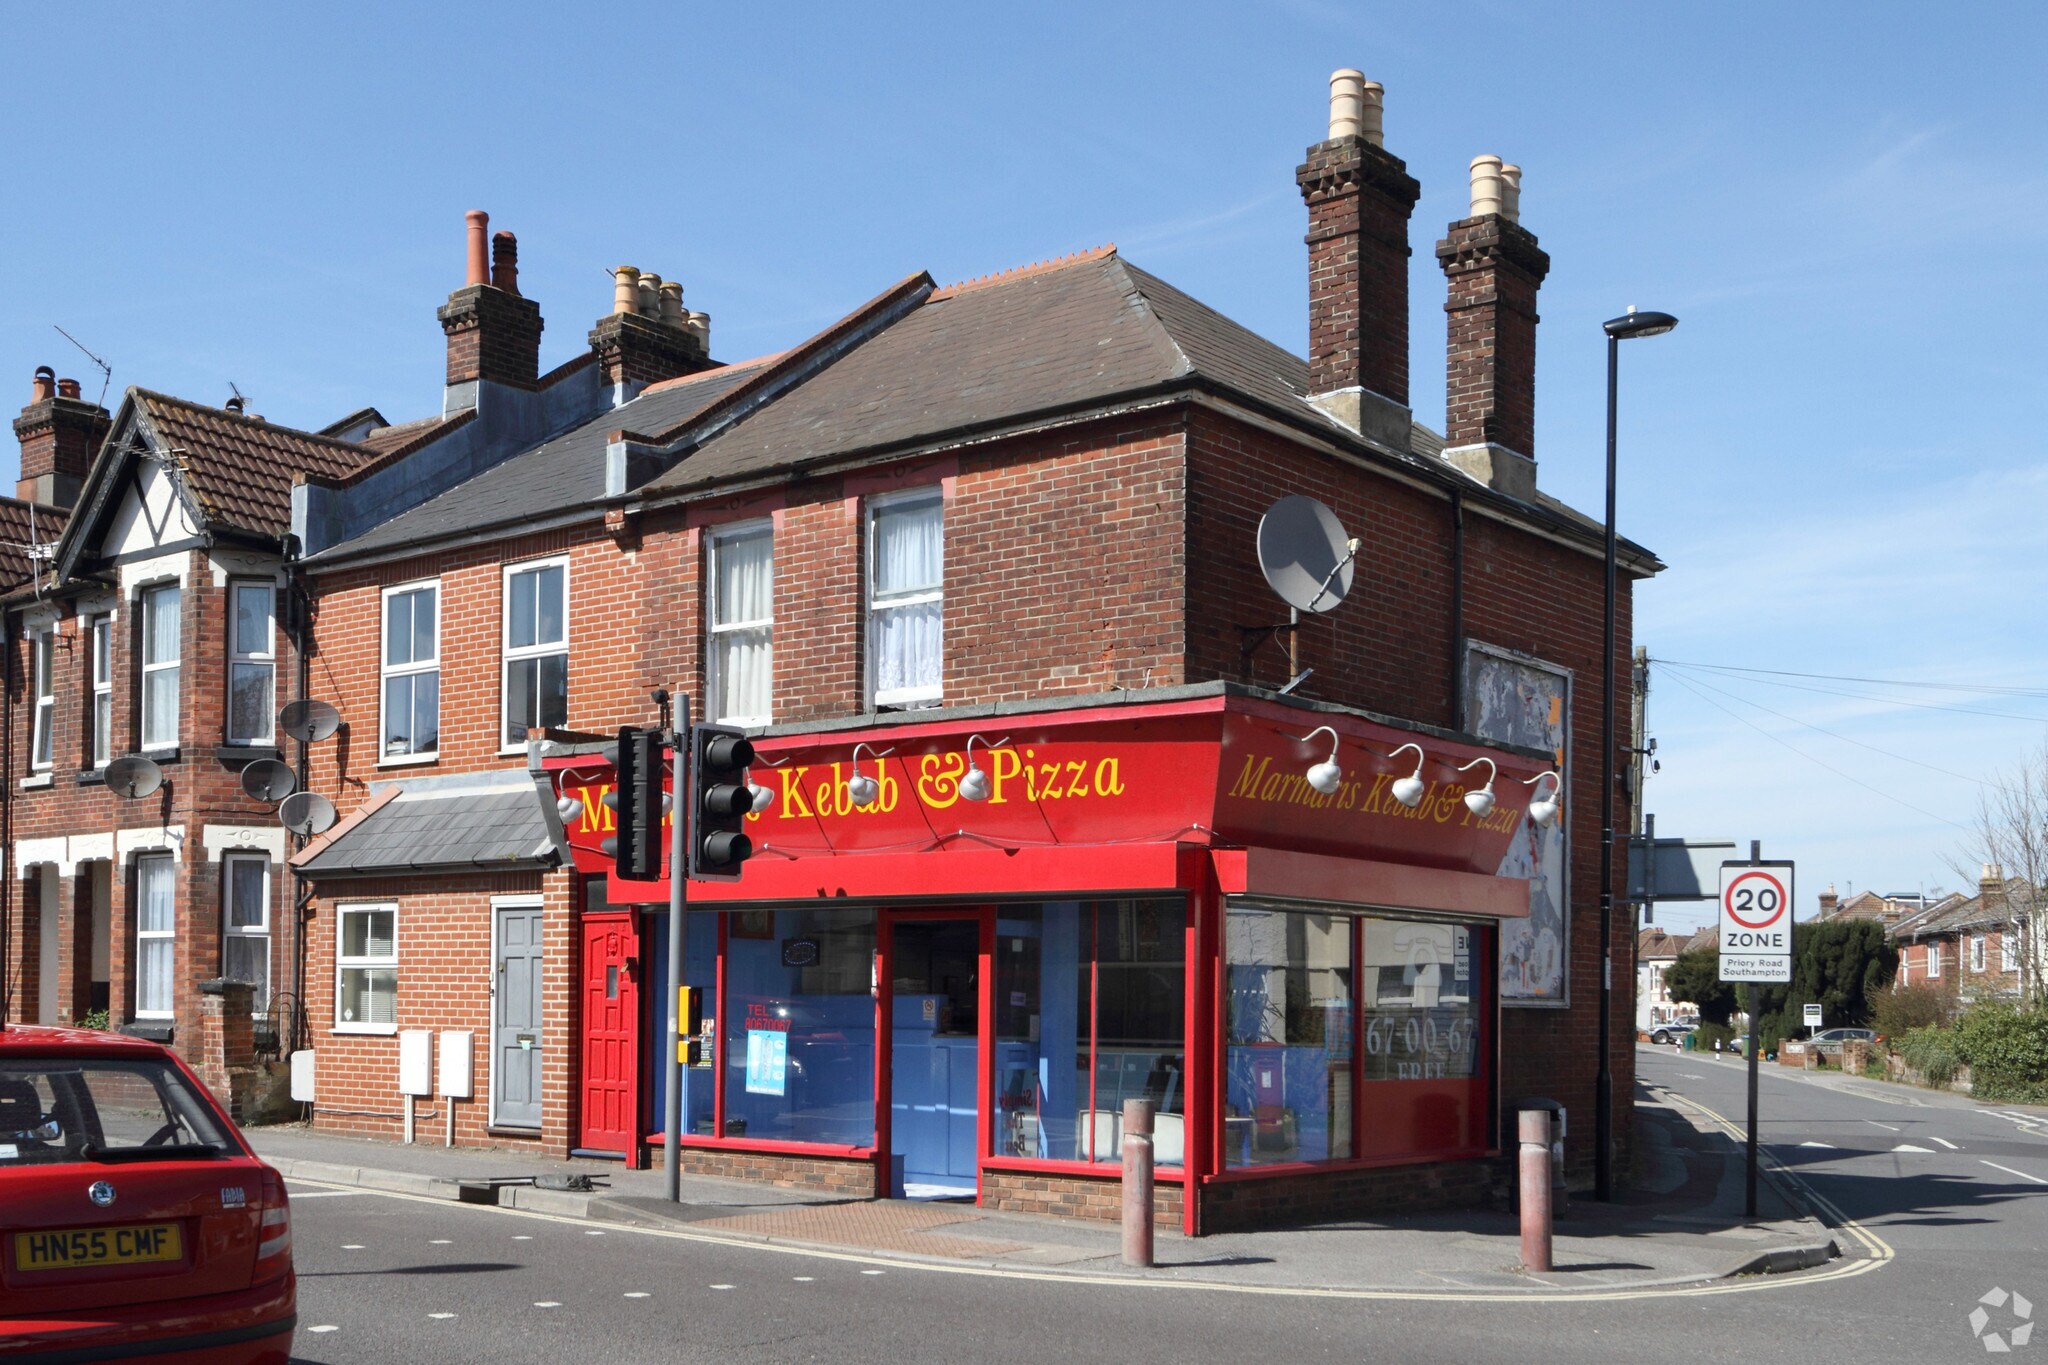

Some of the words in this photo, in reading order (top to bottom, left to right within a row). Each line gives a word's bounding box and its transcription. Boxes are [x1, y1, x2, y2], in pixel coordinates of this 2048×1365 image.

[917, 752, 965, 809] &
[988, 748, 1125, 804] Pizza
[1736, 888, 1777, 911] 20
[1728, 933, 1783, 947] ZONE
[1727, 959, 1755, 968] Priory
[1759, 959, 1783, 967] Road
[1723, 968, 1787, 977] Southampton
[221, 1187, 245, 1203] FABIA
[29, 1231, 108, 1263] HN55
[116, 1228, 168, 1258] CMF
